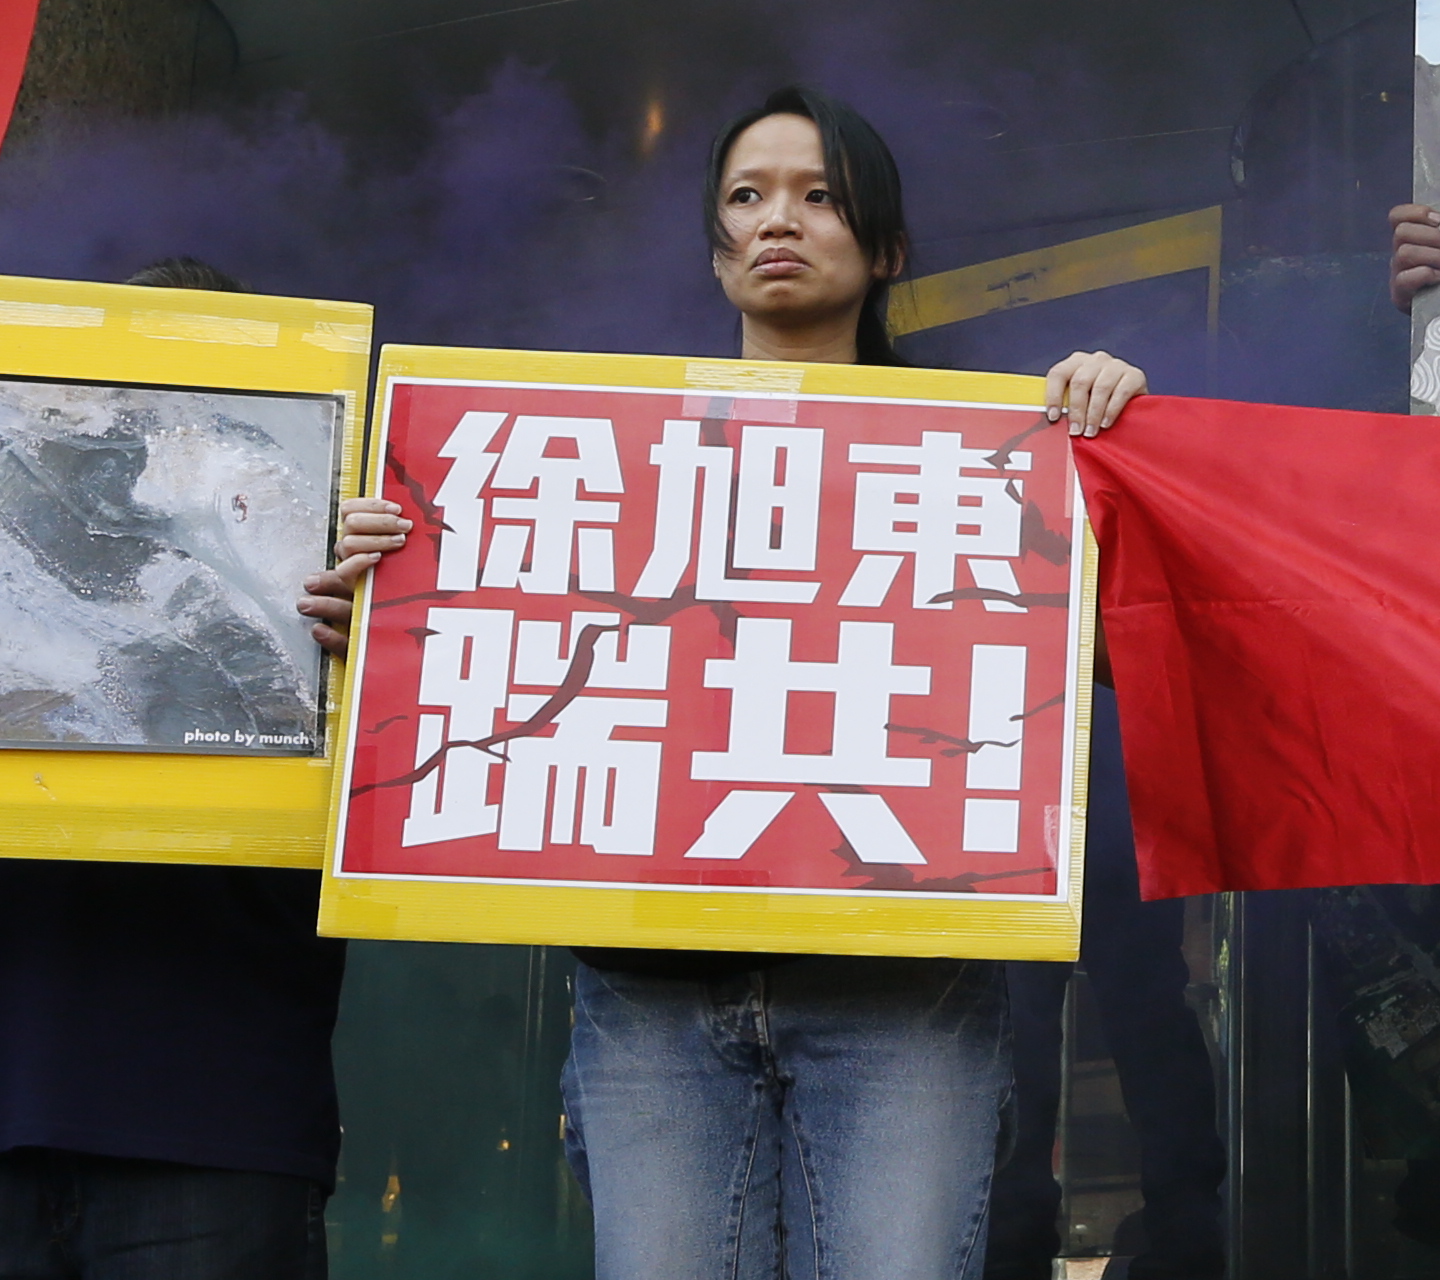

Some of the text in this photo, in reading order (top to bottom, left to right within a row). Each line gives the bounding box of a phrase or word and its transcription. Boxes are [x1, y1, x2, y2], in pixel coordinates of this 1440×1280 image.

[433, 411, 1032, 613] 徐旭東
[184, 728, 309, 746] photo by munch
[401, 607, 1028, 865] 踹共!
